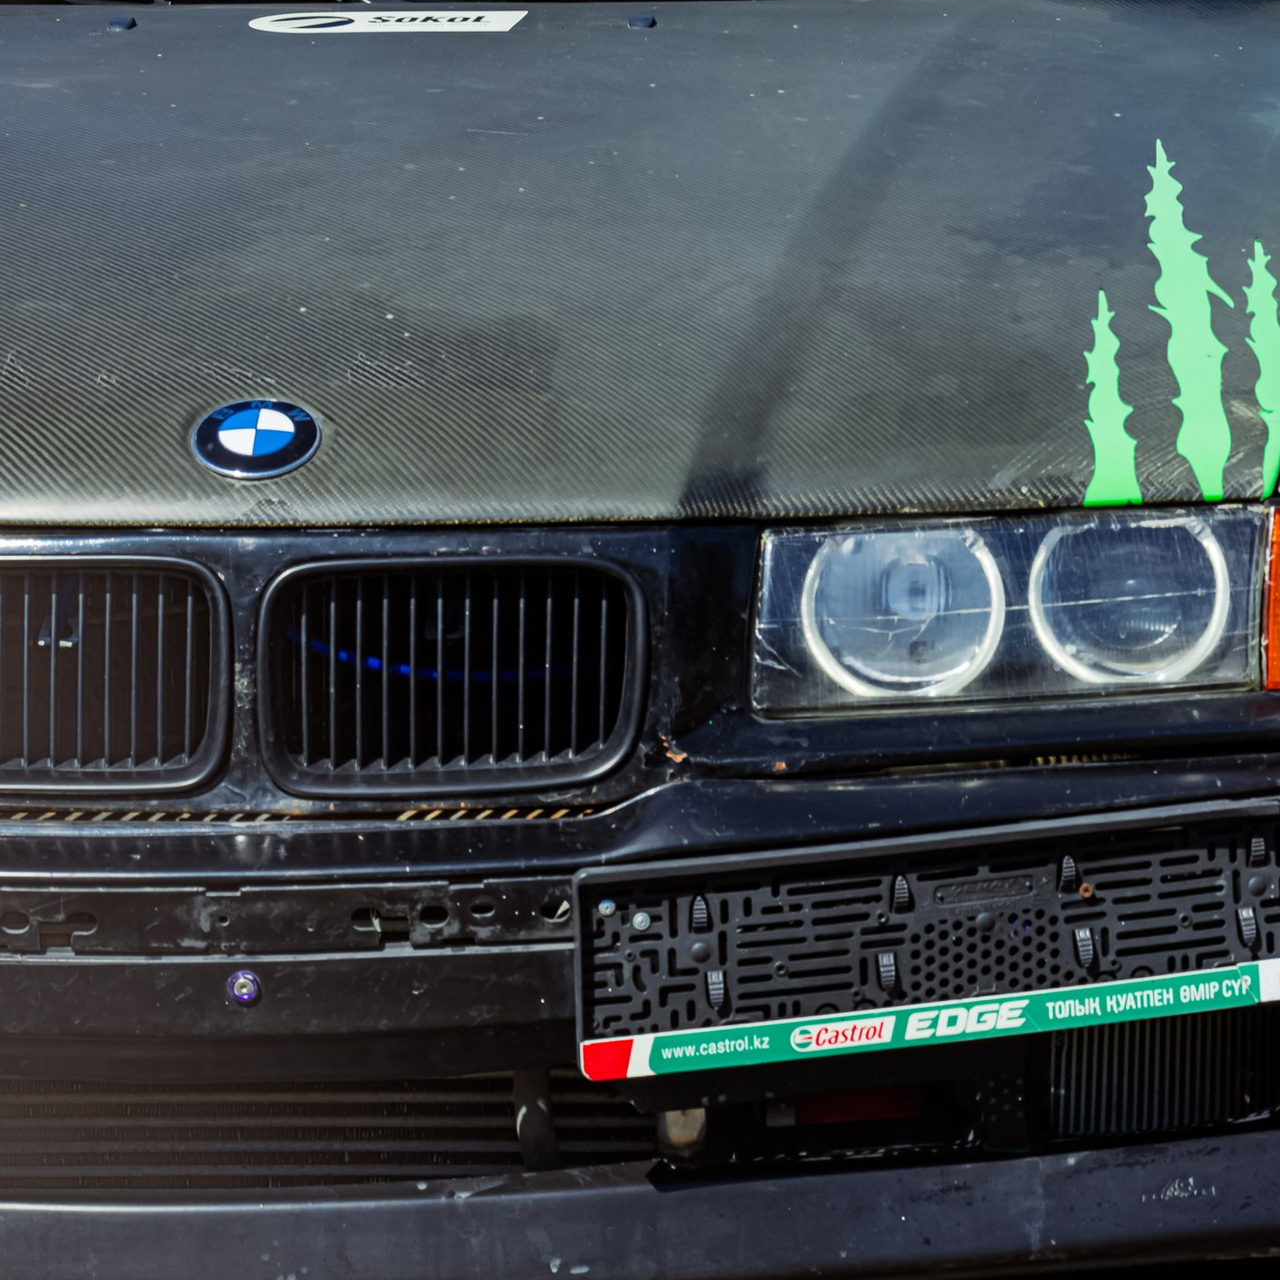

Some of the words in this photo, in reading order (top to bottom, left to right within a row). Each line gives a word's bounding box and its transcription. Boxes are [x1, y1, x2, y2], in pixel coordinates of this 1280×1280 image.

[1045, 996, 1102, 1020] ТОЛЫҚ
[1106, 987, 1174, 1014] ҚУАТПЕН
[661, 1034, 770, 1060] www.castrol.kz
[815, 1021, 884, 1048] Castrol
[904, 999, 1030, 1041] EDGE
